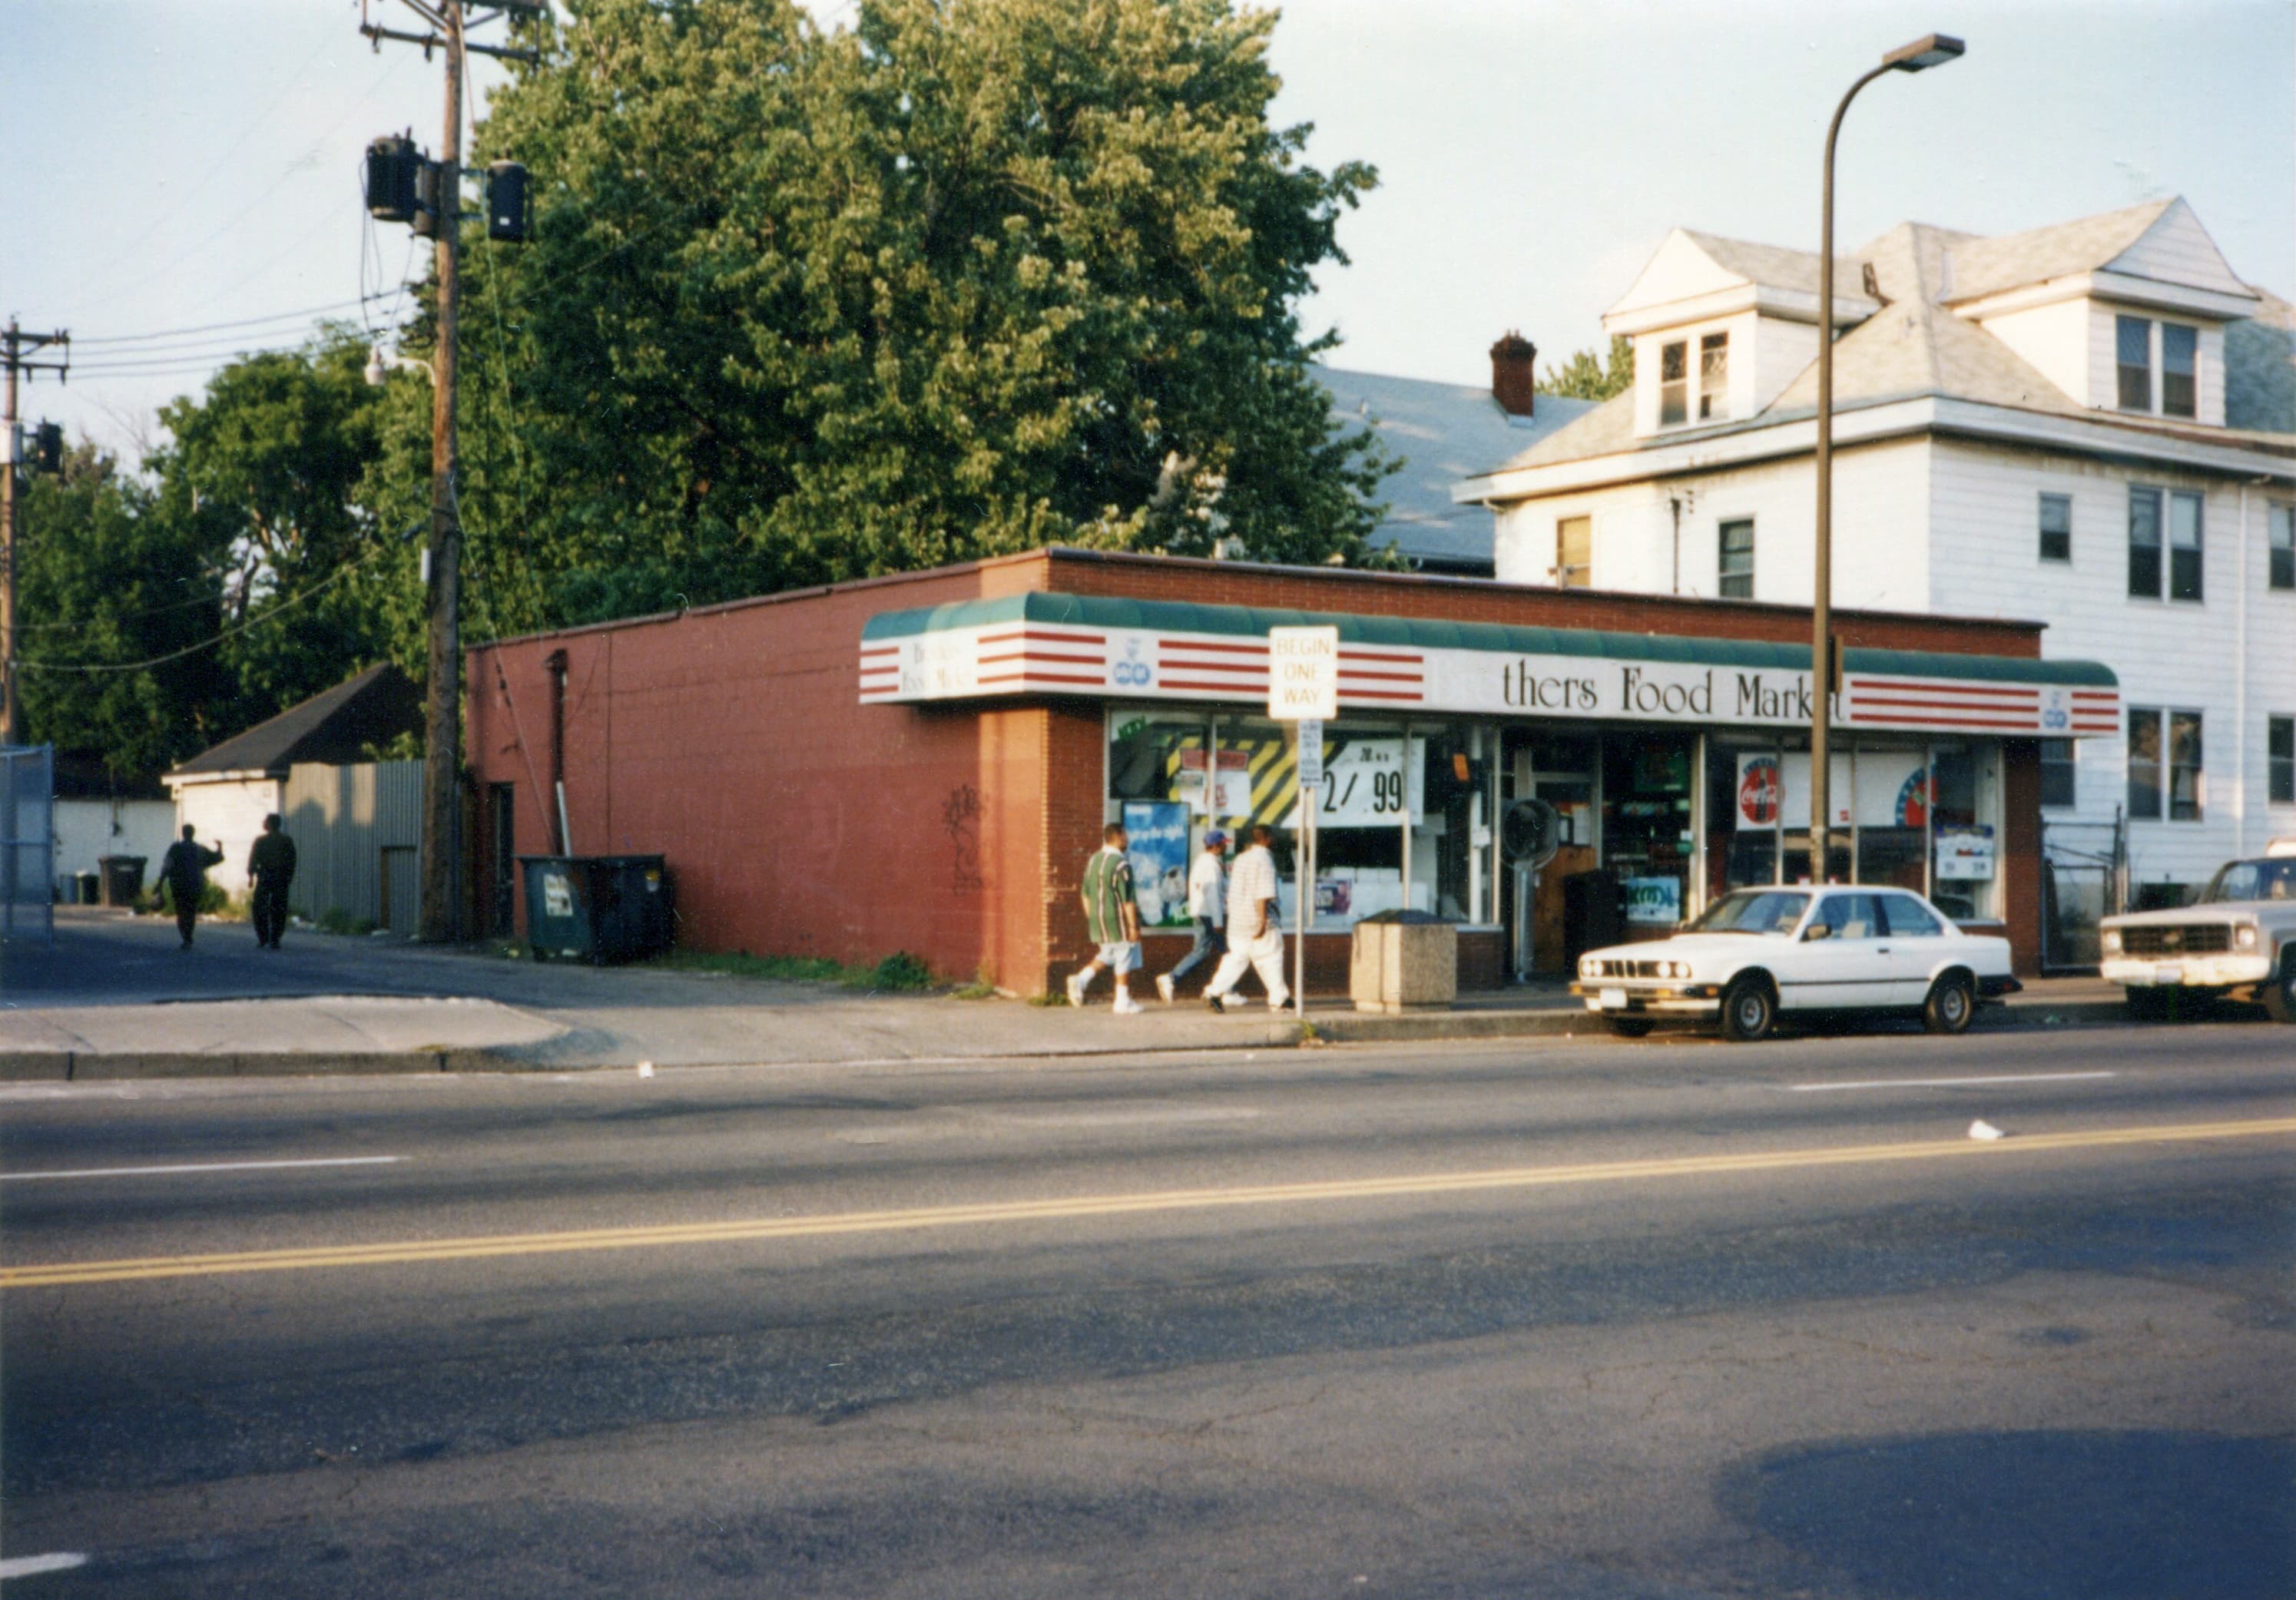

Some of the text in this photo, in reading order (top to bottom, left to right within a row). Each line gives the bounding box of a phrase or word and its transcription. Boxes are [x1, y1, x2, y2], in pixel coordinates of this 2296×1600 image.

[1277, 638, 1330, 656] BEGIN
[1284, 662, 1319, 681] ONE
[1284, 687, 1321, 704] WAY
[1622, 667, 1712, 714] Food
[1735, 673, 1845, 720] Markt
